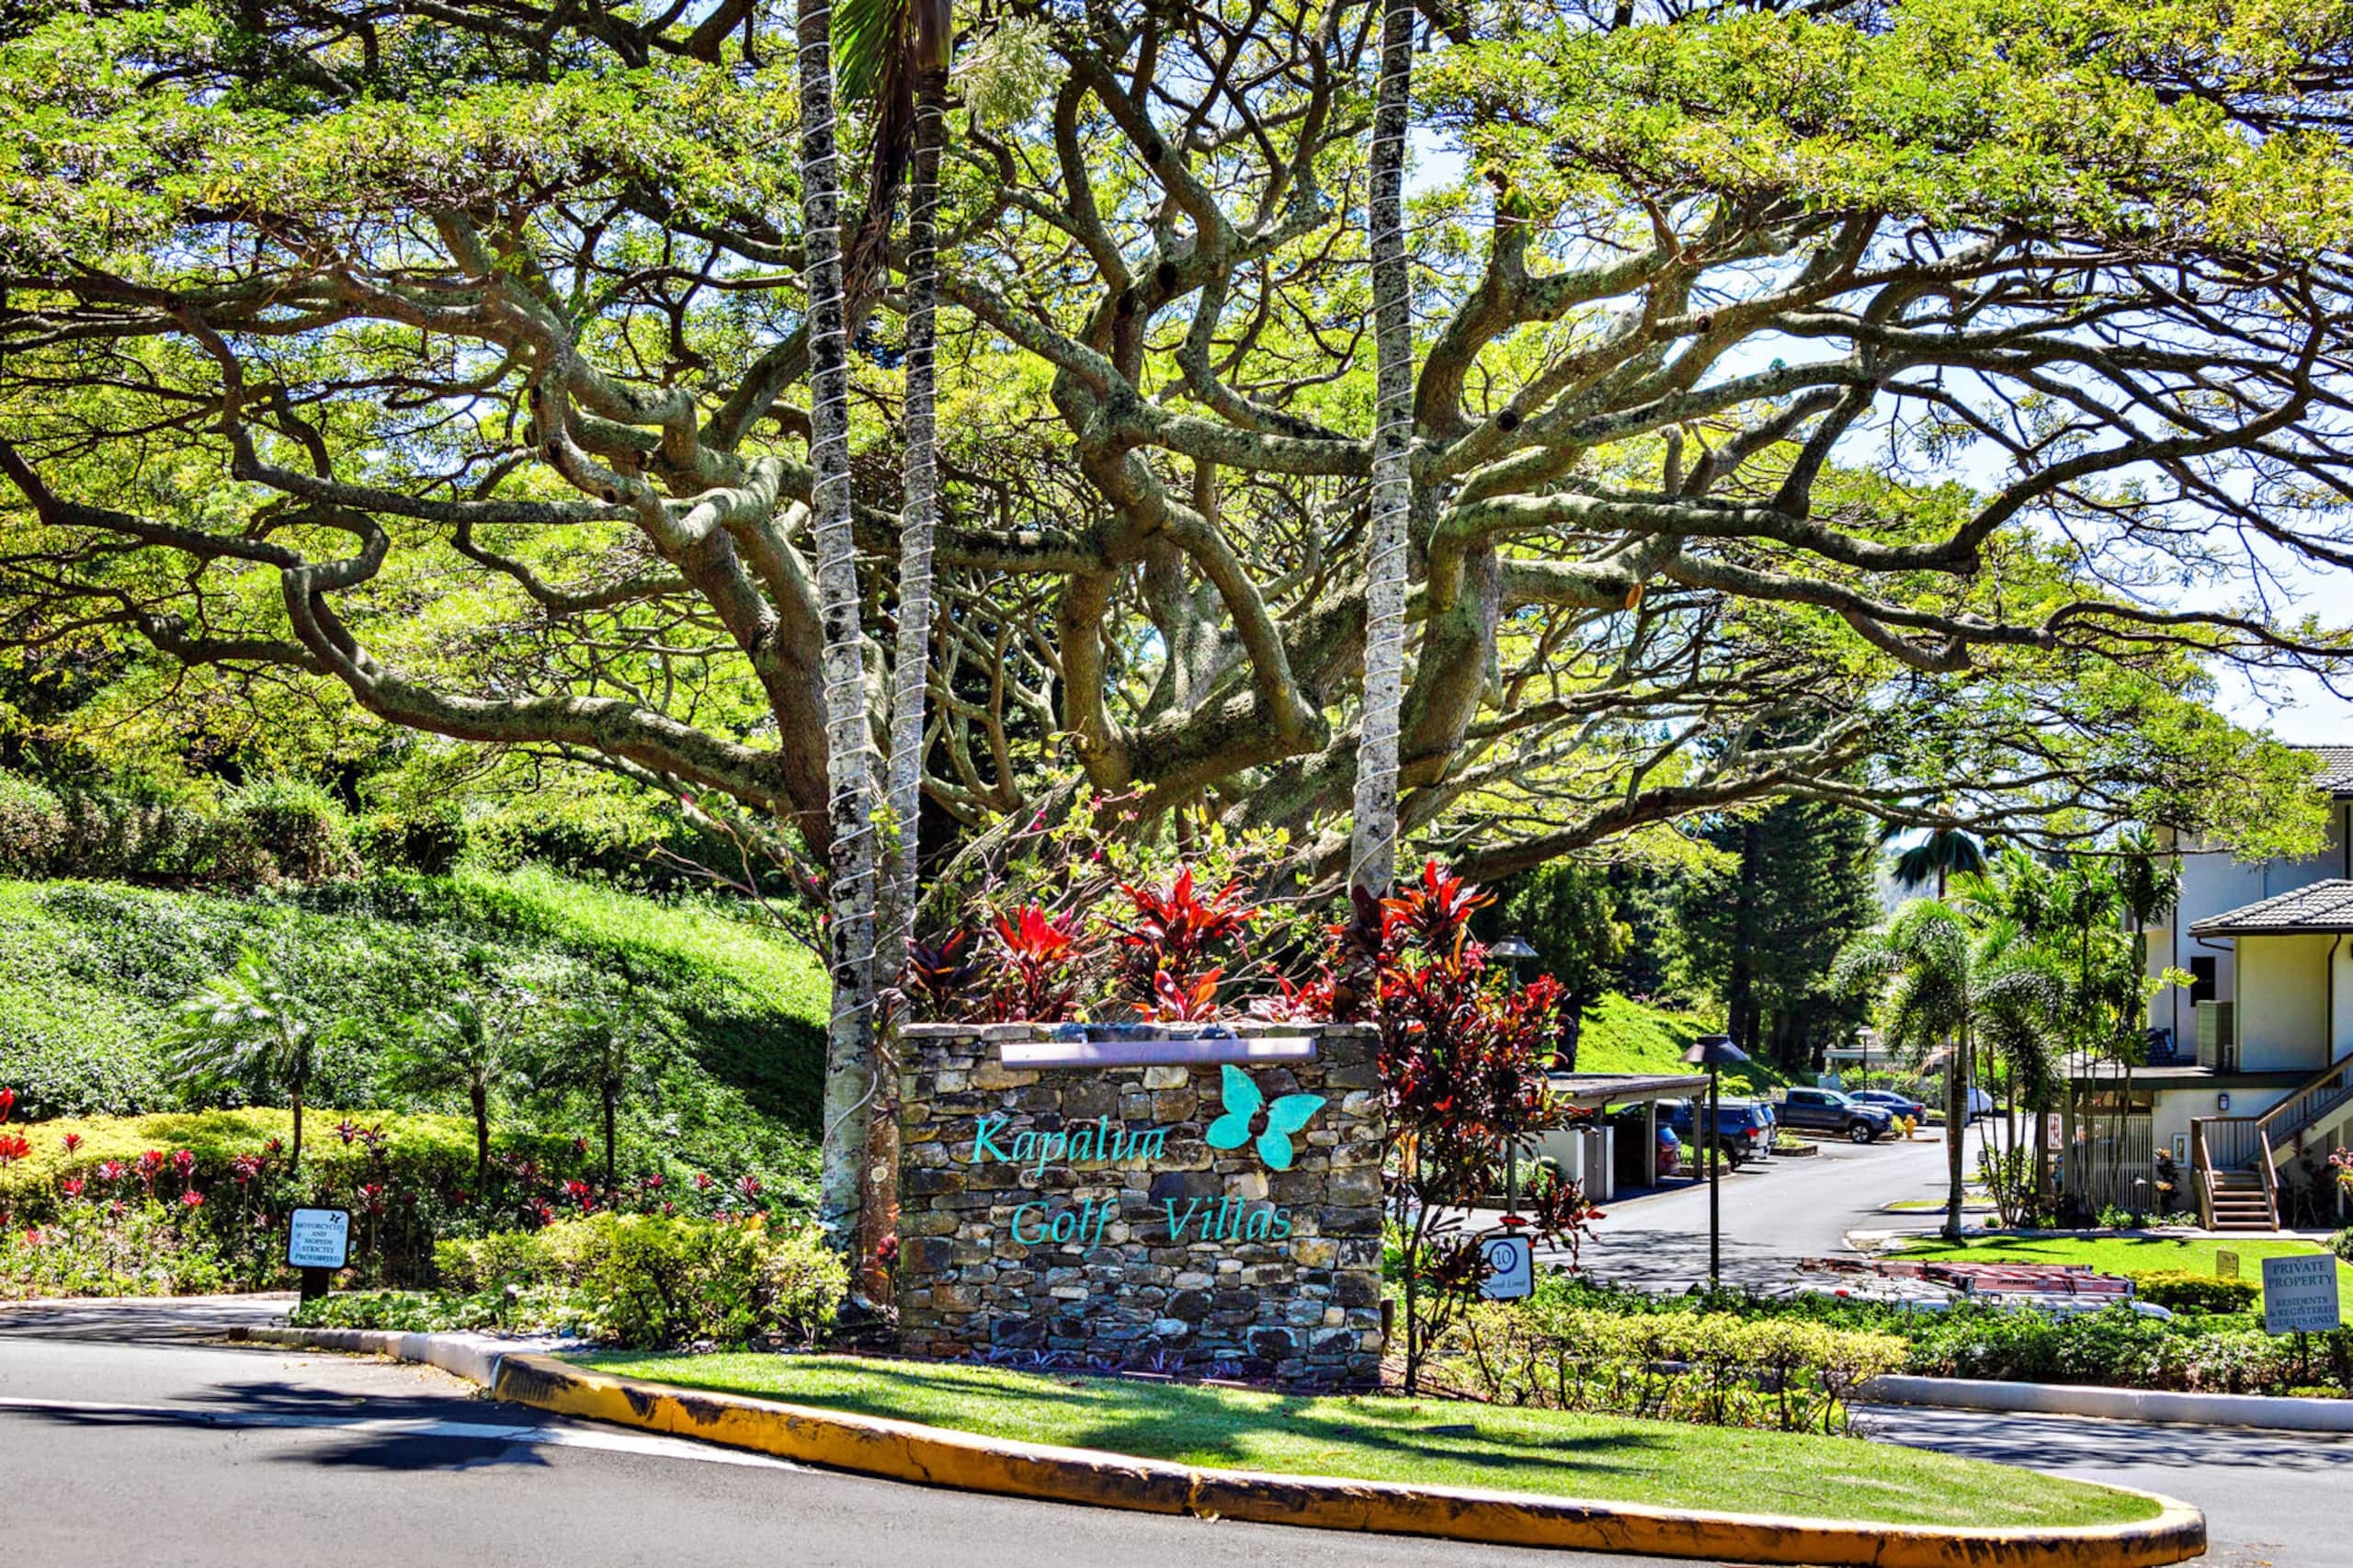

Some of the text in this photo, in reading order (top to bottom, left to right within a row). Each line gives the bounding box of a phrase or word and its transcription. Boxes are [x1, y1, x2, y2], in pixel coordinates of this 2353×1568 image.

[972, 1114, 1166, 1177] Kapalua
[1012, 1197, 1291, 1259] Golf Villas
[1495, 1249, 1512, 1266] 10
[2273, 1261, 2325, 1275] PRIVATE
[2268, 1274, 2333, 1289] PROPERTY
[2276, 1296, 2328, 1307] RESIDENTS
[2278, 1305, 2336, 1316] REGISTERED
[2309, 1315, 2336, 1324] ONLY
